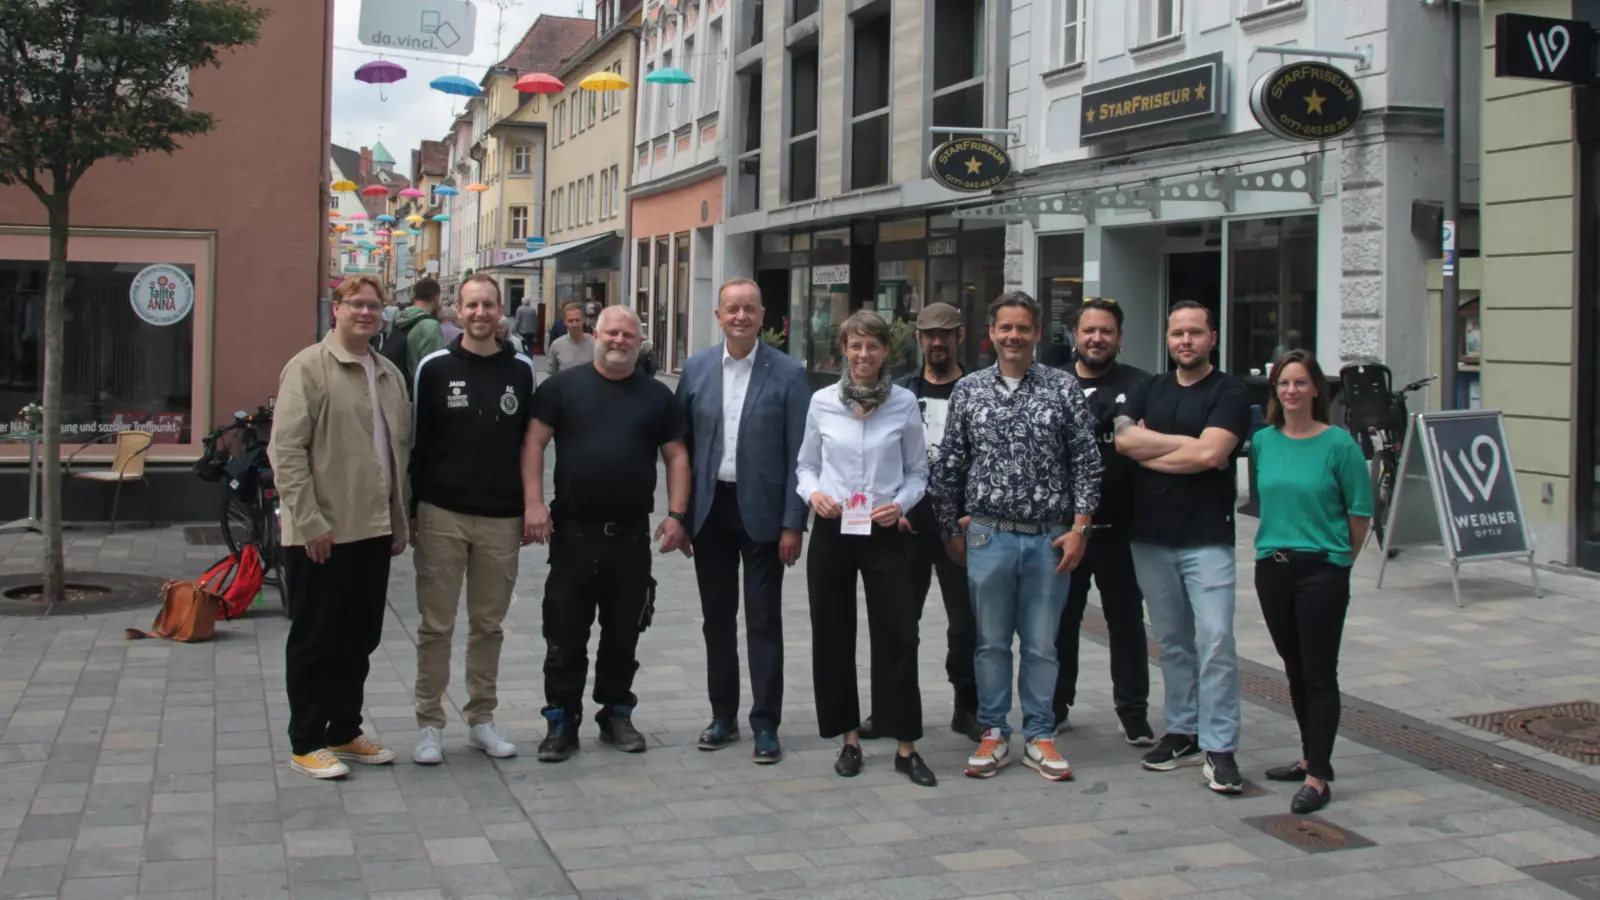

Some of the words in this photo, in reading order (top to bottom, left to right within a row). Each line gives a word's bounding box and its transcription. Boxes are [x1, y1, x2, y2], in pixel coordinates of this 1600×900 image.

[148, 285, 176, 300] Tante
[147, 298, 177, 311] ANNA
[80, 421, 97, 432] und
[1455, 511, 1517, 529] WERNER
